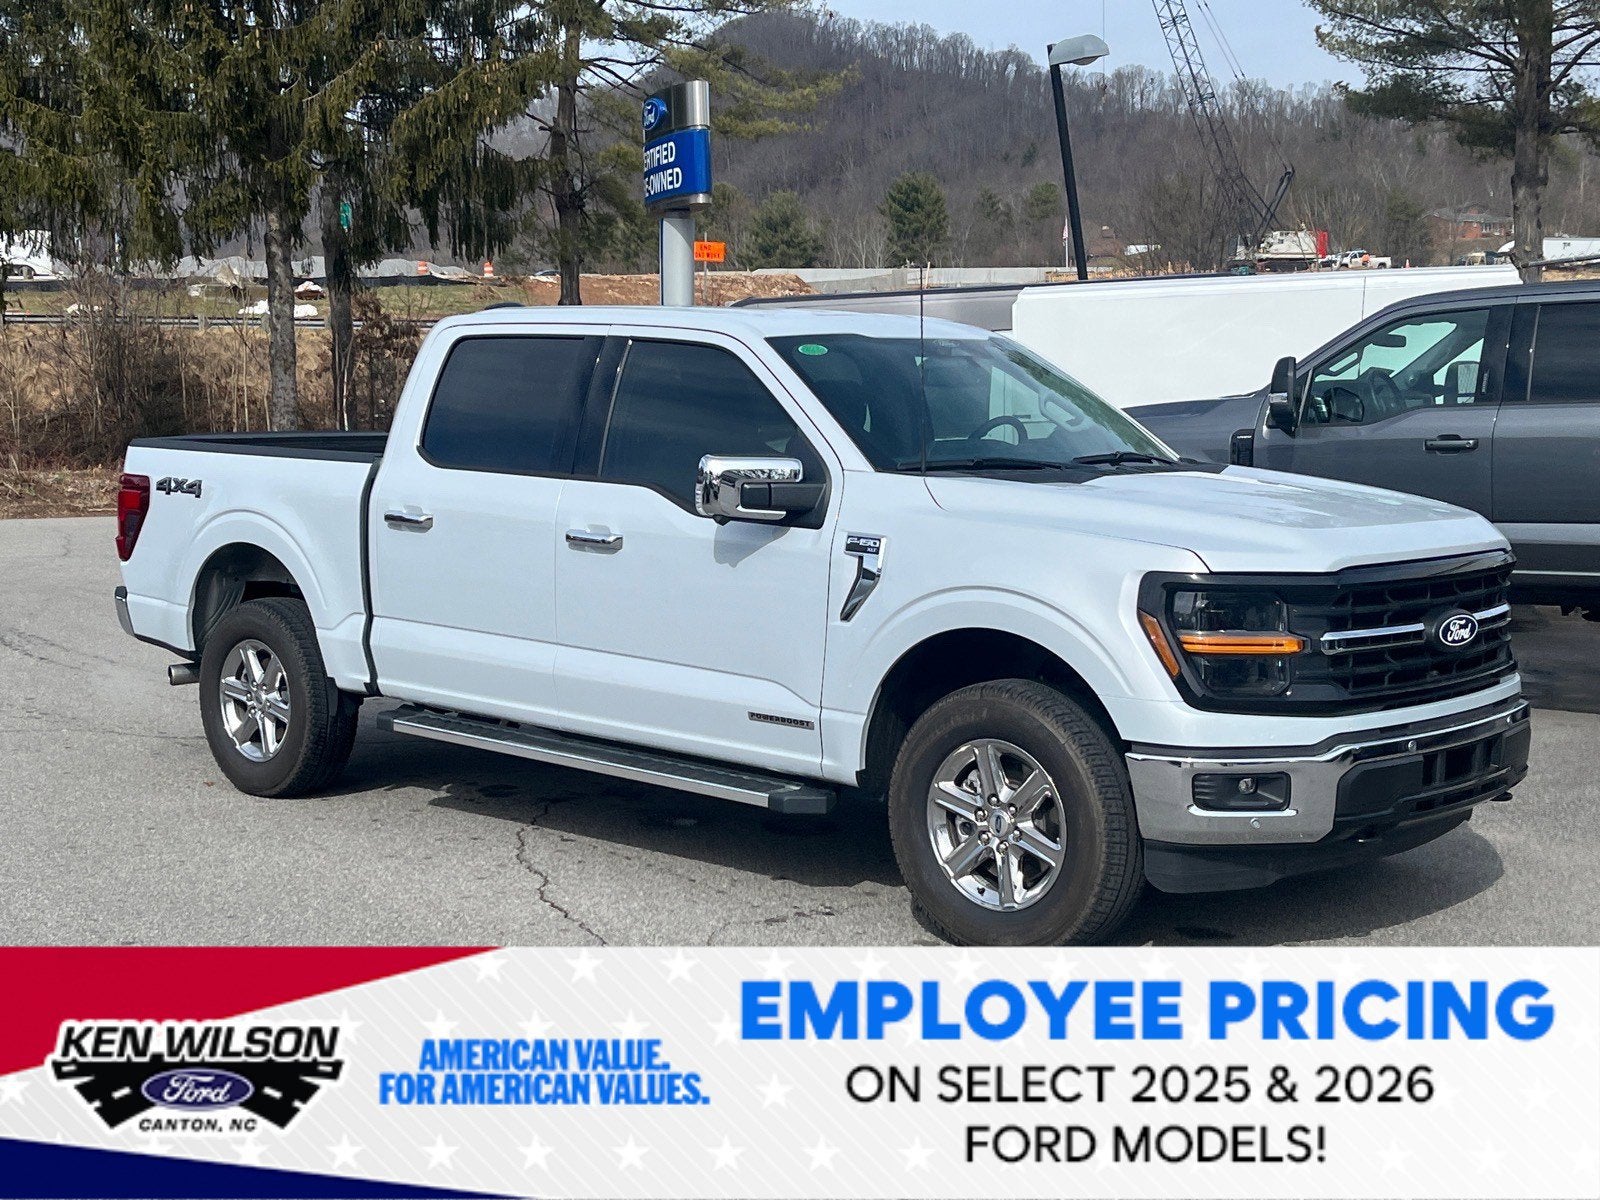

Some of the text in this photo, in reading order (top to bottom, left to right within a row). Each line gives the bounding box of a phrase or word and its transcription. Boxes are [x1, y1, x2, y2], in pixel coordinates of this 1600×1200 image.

[643, 141, 676, 172] ERTIFIED
[1447, 619, 1472, 642] Ford
[750, 711, 810, 727] POWERBOOST
